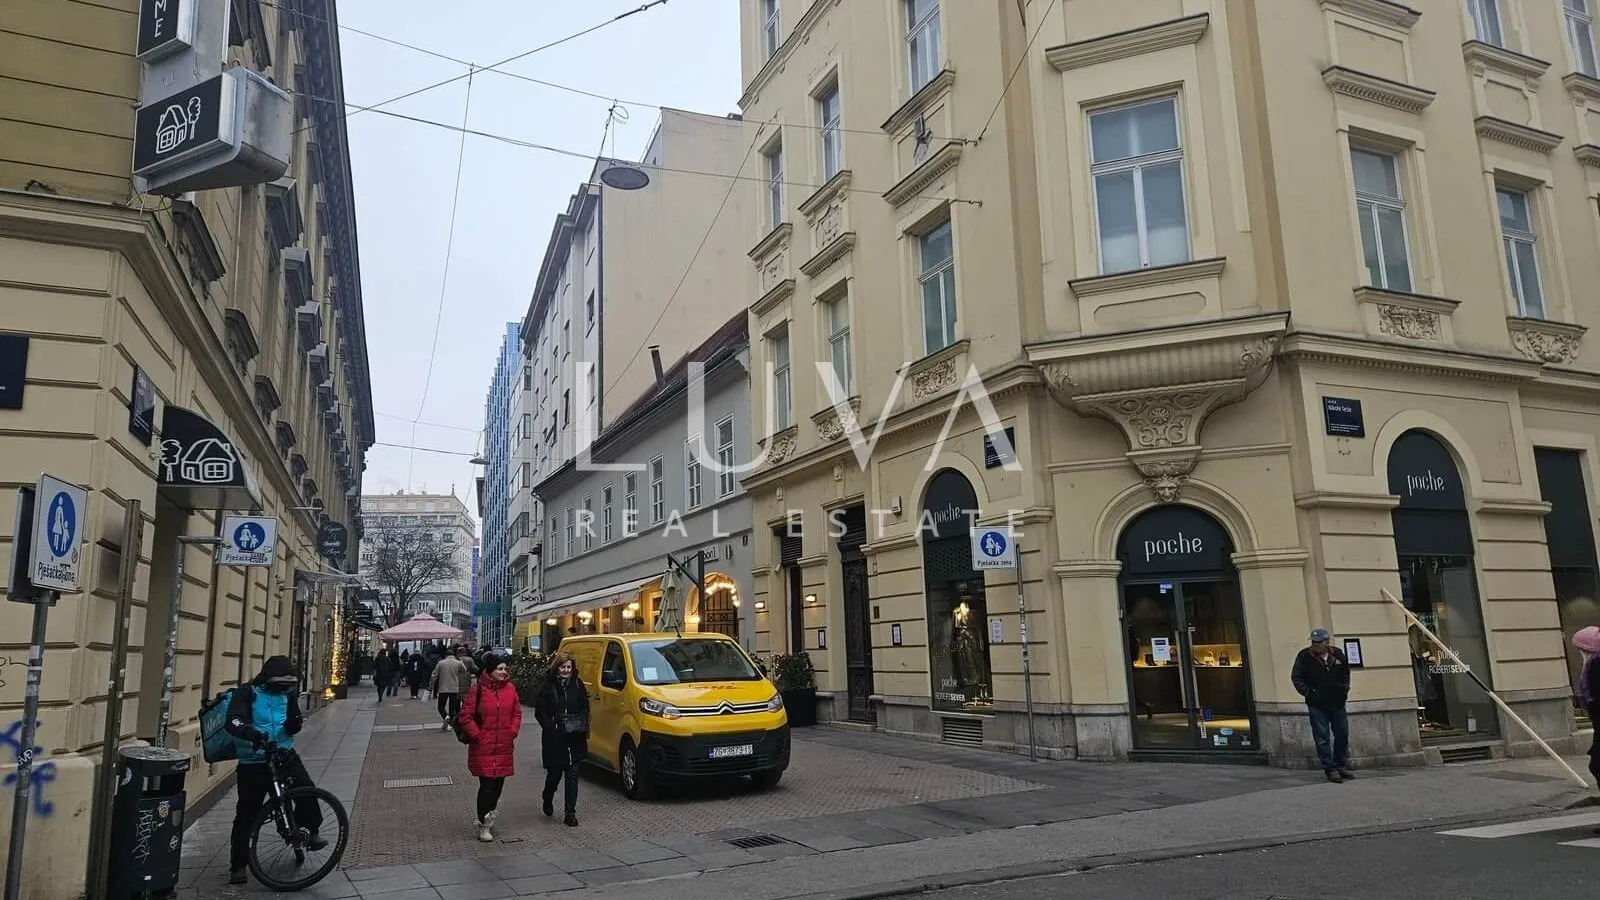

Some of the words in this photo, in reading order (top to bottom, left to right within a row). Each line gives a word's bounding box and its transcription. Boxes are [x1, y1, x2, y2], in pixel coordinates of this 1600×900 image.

[1407, 469, 1444, 497] poche
[933, 502, 961, 527] poche
[1144, 531, 1203, 563] poche
